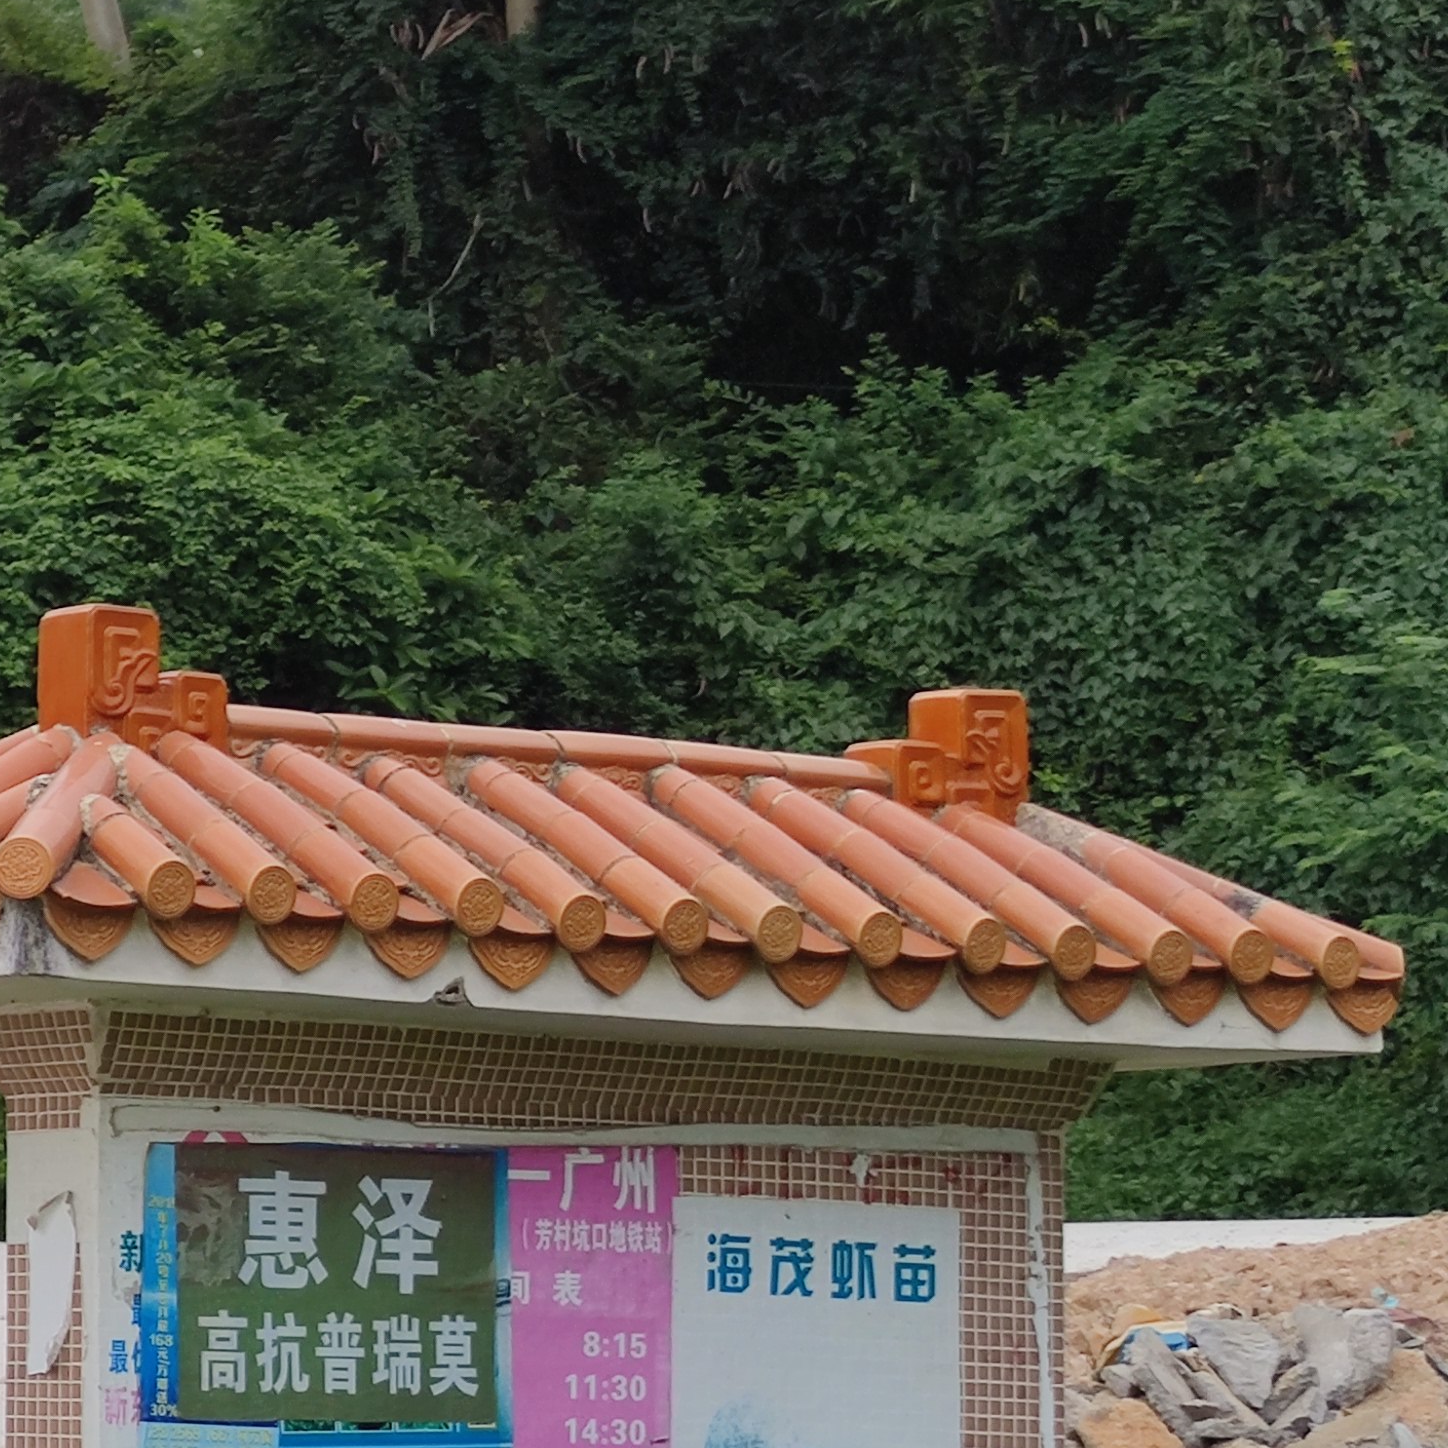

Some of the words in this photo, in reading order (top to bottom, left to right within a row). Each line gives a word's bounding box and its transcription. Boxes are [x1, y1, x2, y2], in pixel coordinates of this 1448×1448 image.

[237, 1170, 443, 1295] 惠泽
[706, 1233, 937, 1303] 海茂虾苗
[197, 1309, 479, 1397] 高抗普瑞莫
[583, 1331, 647, 1359] 8:15
[565, 1374, 647, 1401] 11:30
[564, 1418, 646, 1445] 14:30
